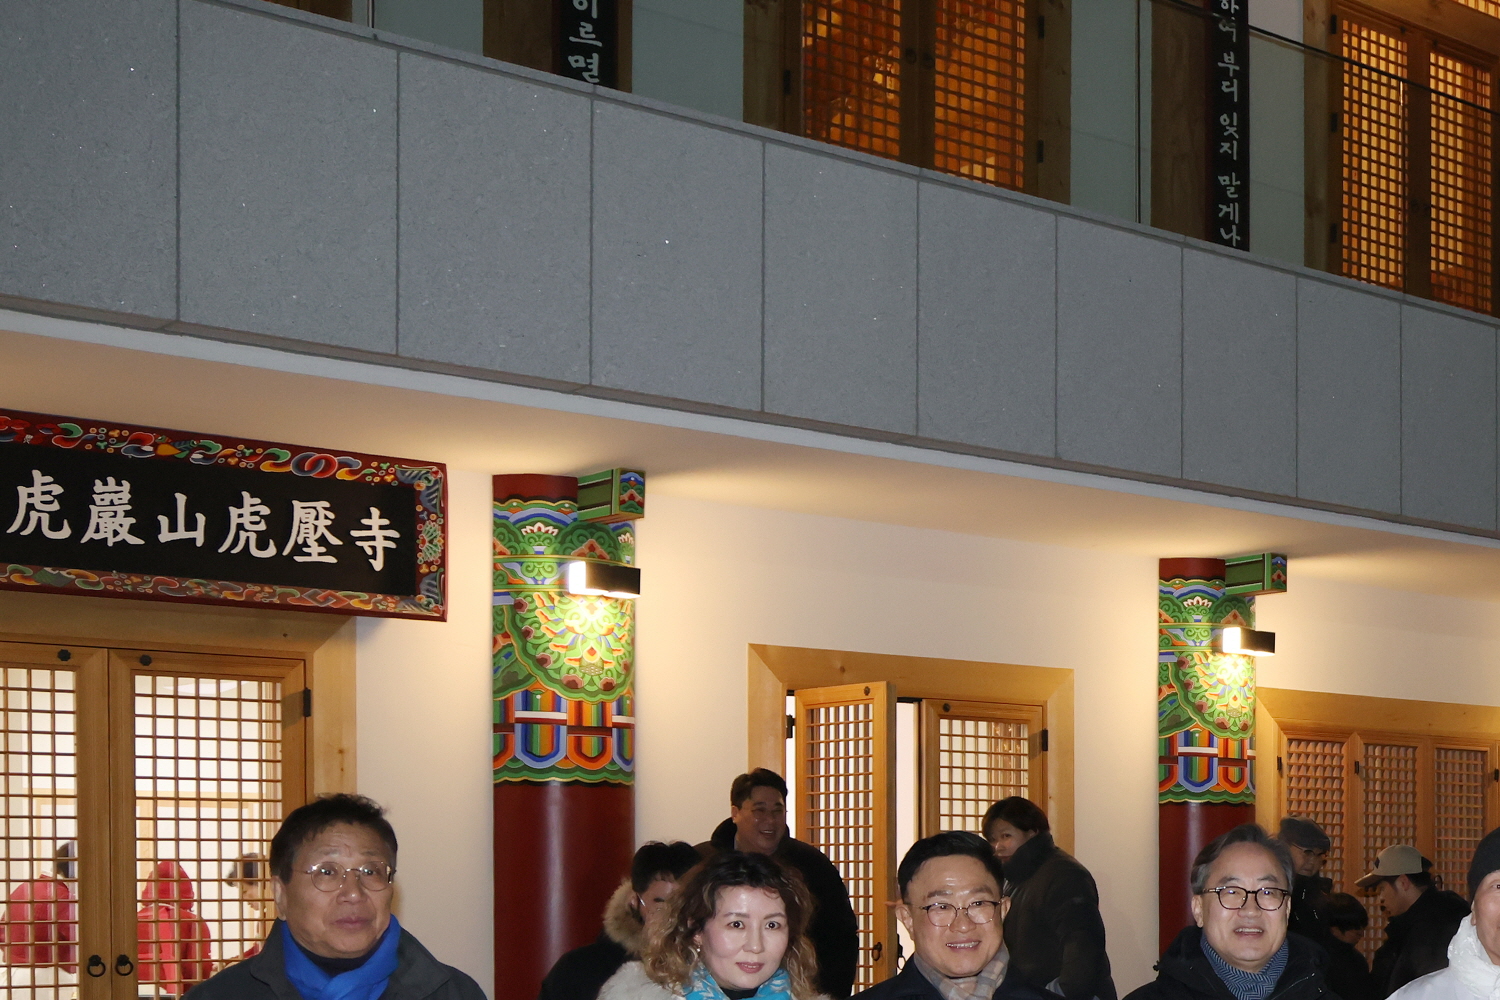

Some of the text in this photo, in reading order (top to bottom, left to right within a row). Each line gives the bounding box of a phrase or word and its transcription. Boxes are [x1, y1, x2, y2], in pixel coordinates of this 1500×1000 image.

[1217, 51, 1240, 102] 부디
[1219, 112, 1239, 161] 잊지
[1217, 171, 1241, 247] 말게나
